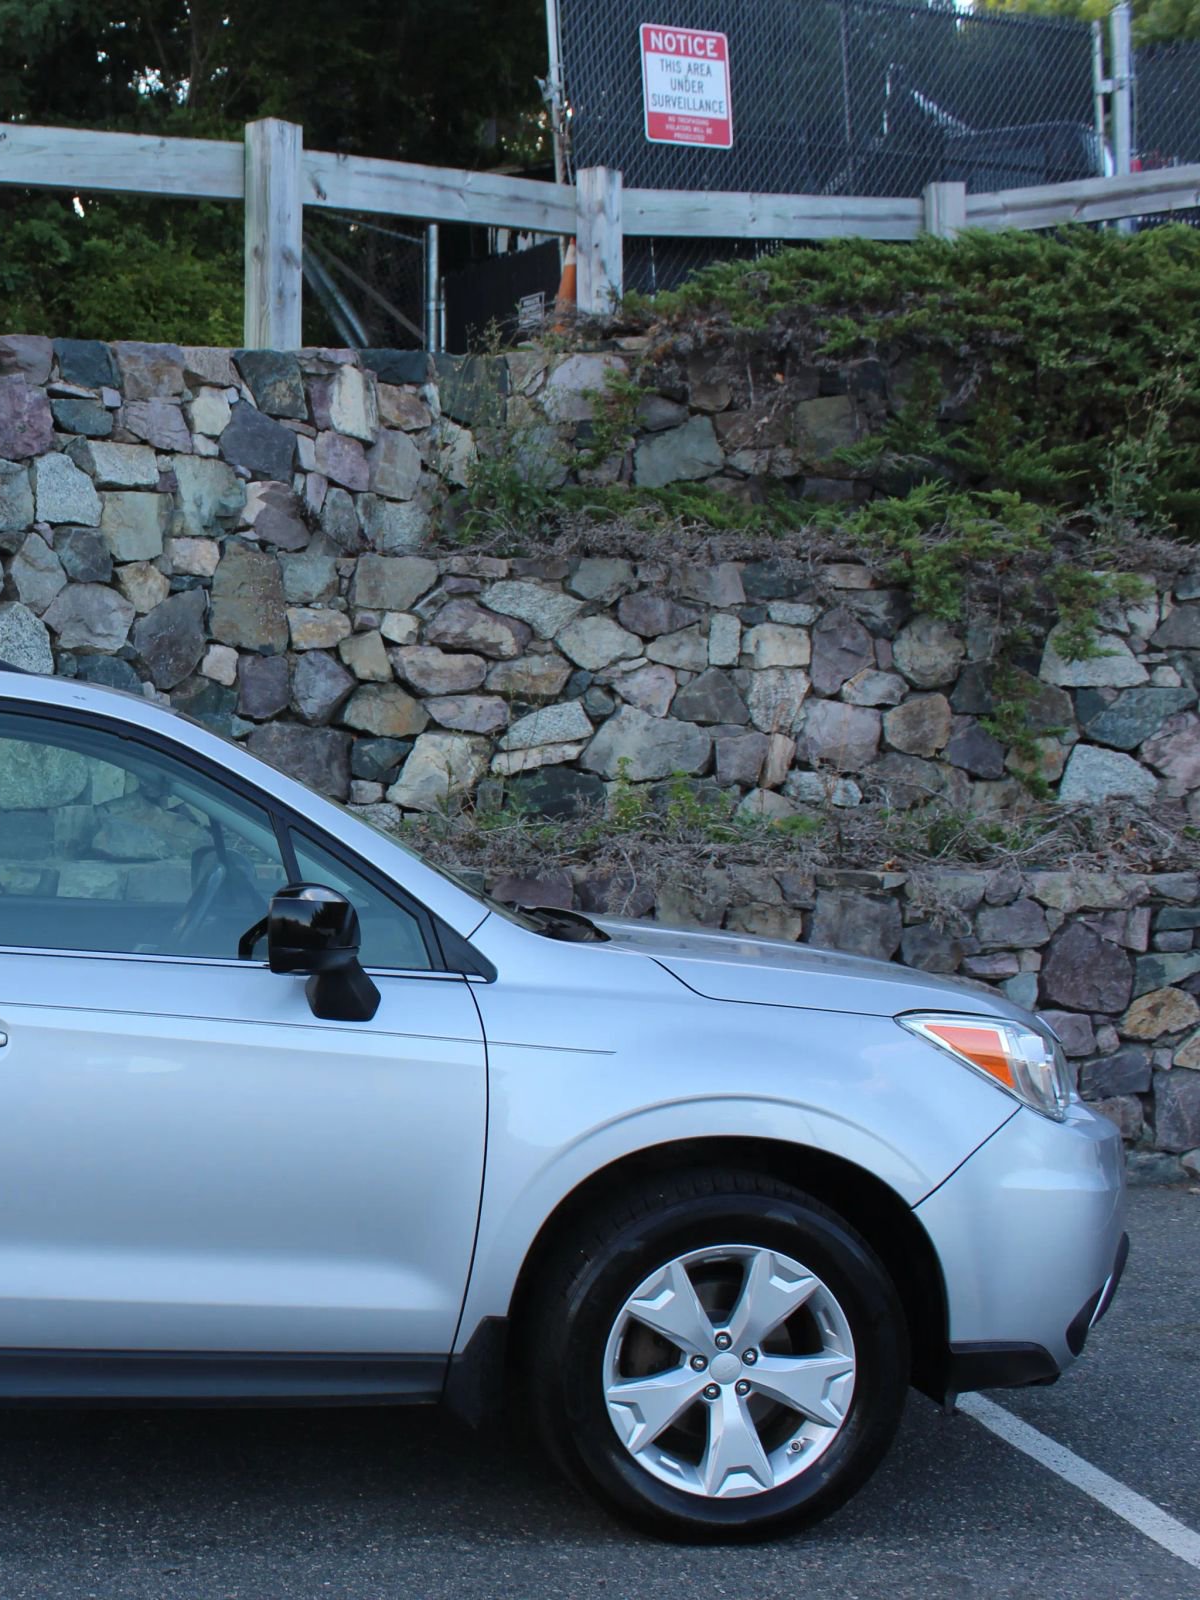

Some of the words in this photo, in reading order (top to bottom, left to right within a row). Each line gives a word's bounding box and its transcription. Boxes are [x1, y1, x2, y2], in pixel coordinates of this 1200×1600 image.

[650, 31, 718, 57] NOTICE
[660, 58, 682, 74] THIS
[687, 62, 712, 77] AREA
[670, 77, 704, 94] UNDER
[651, 93, 725, 114] SURVEILLANCE
